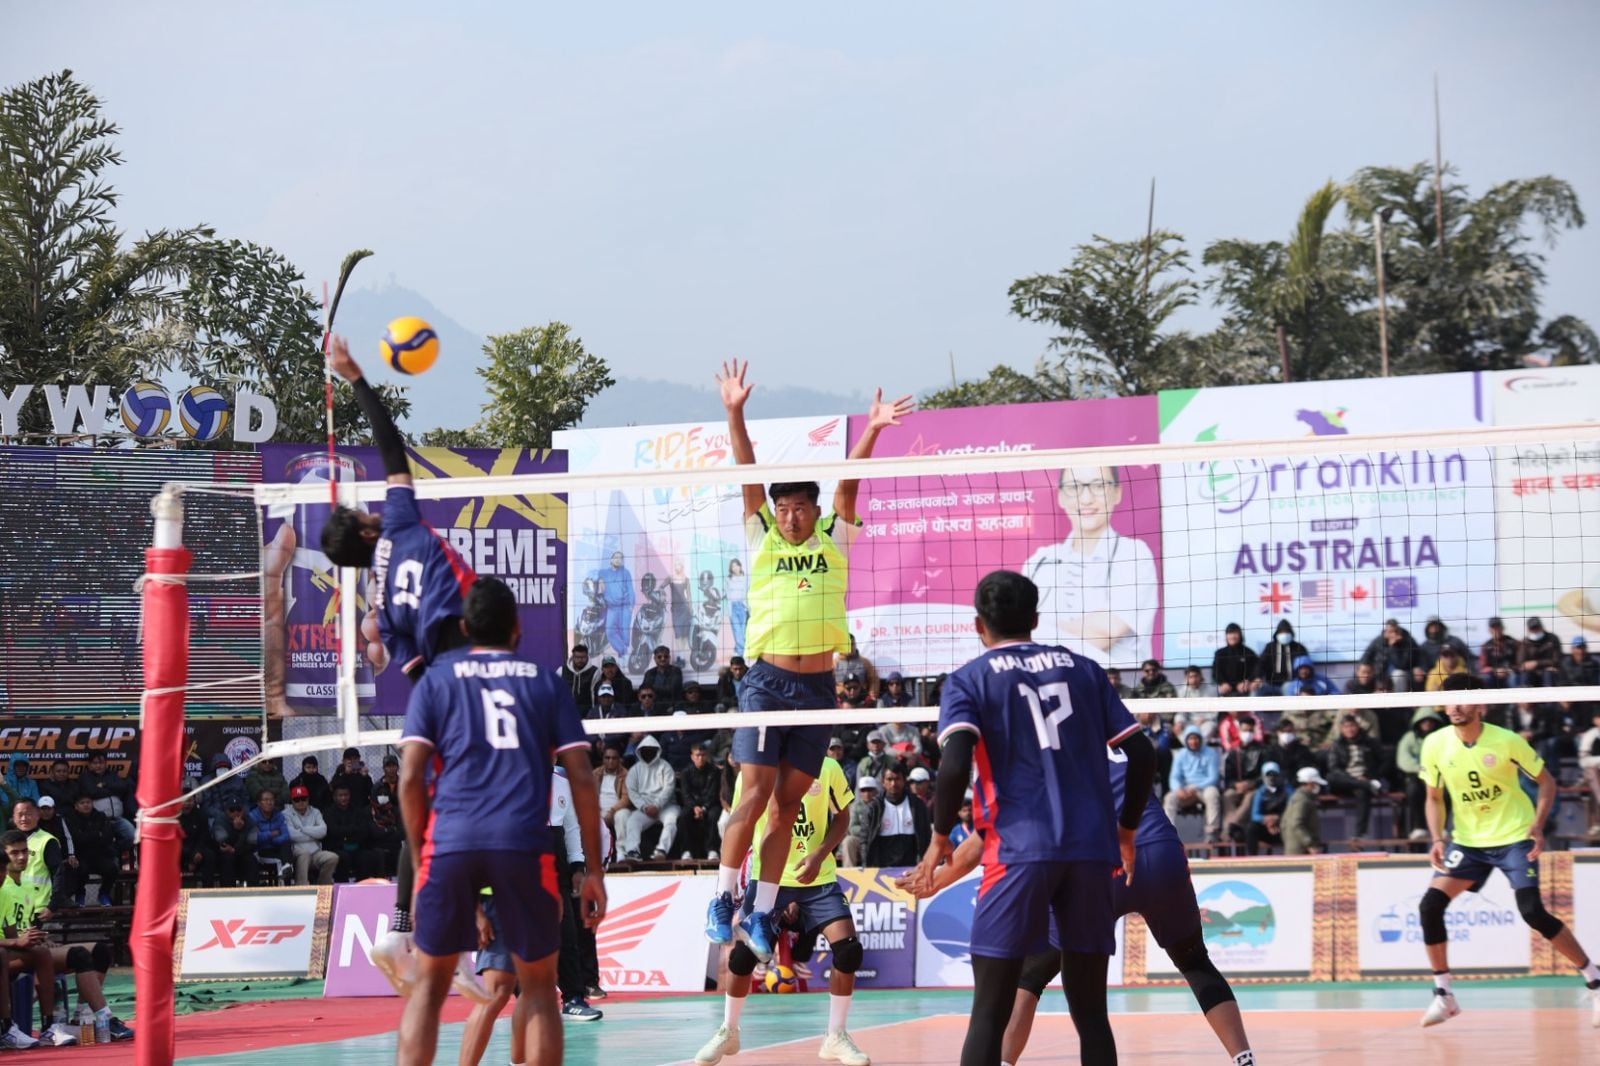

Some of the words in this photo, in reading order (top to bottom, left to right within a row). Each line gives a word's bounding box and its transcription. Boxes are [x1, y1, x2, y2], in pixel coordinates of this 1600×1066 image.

[634, 427, 703, 468] RIDE
[433, 528, 557, 575] REME
[1233, 535, 1440, 575] AUSTRALIA
[776, 553, 828, 573] AIWA
[504, 577, 556, 604] RINK
[893, 625, 921, 636] TIKA
[291, 652, 329, 662] ENERGY
[988, 652, 1075, 674] MALDIVES
[453, 661, 538, 678] MALDIVES
[306, 685, 337, 696] CLASSI
[481, 688, 520, 749] 6
[1018, 681, 1074, 750] 17
[67, 728, 135, 750] CUP
[222, 727, 255, 735] ORGANIZED
[1468, 771, 1482, 789] 9
[1462, 784, 1503, 803] AIWA
[1444, 849, 1464, 868] 9
[13, 902, 24, 922] 16
[1406, 910, 1515, 926] AAPURNA
[192, 919, 305, 951] XTEP
[598, 969, 671, 986] NDA
